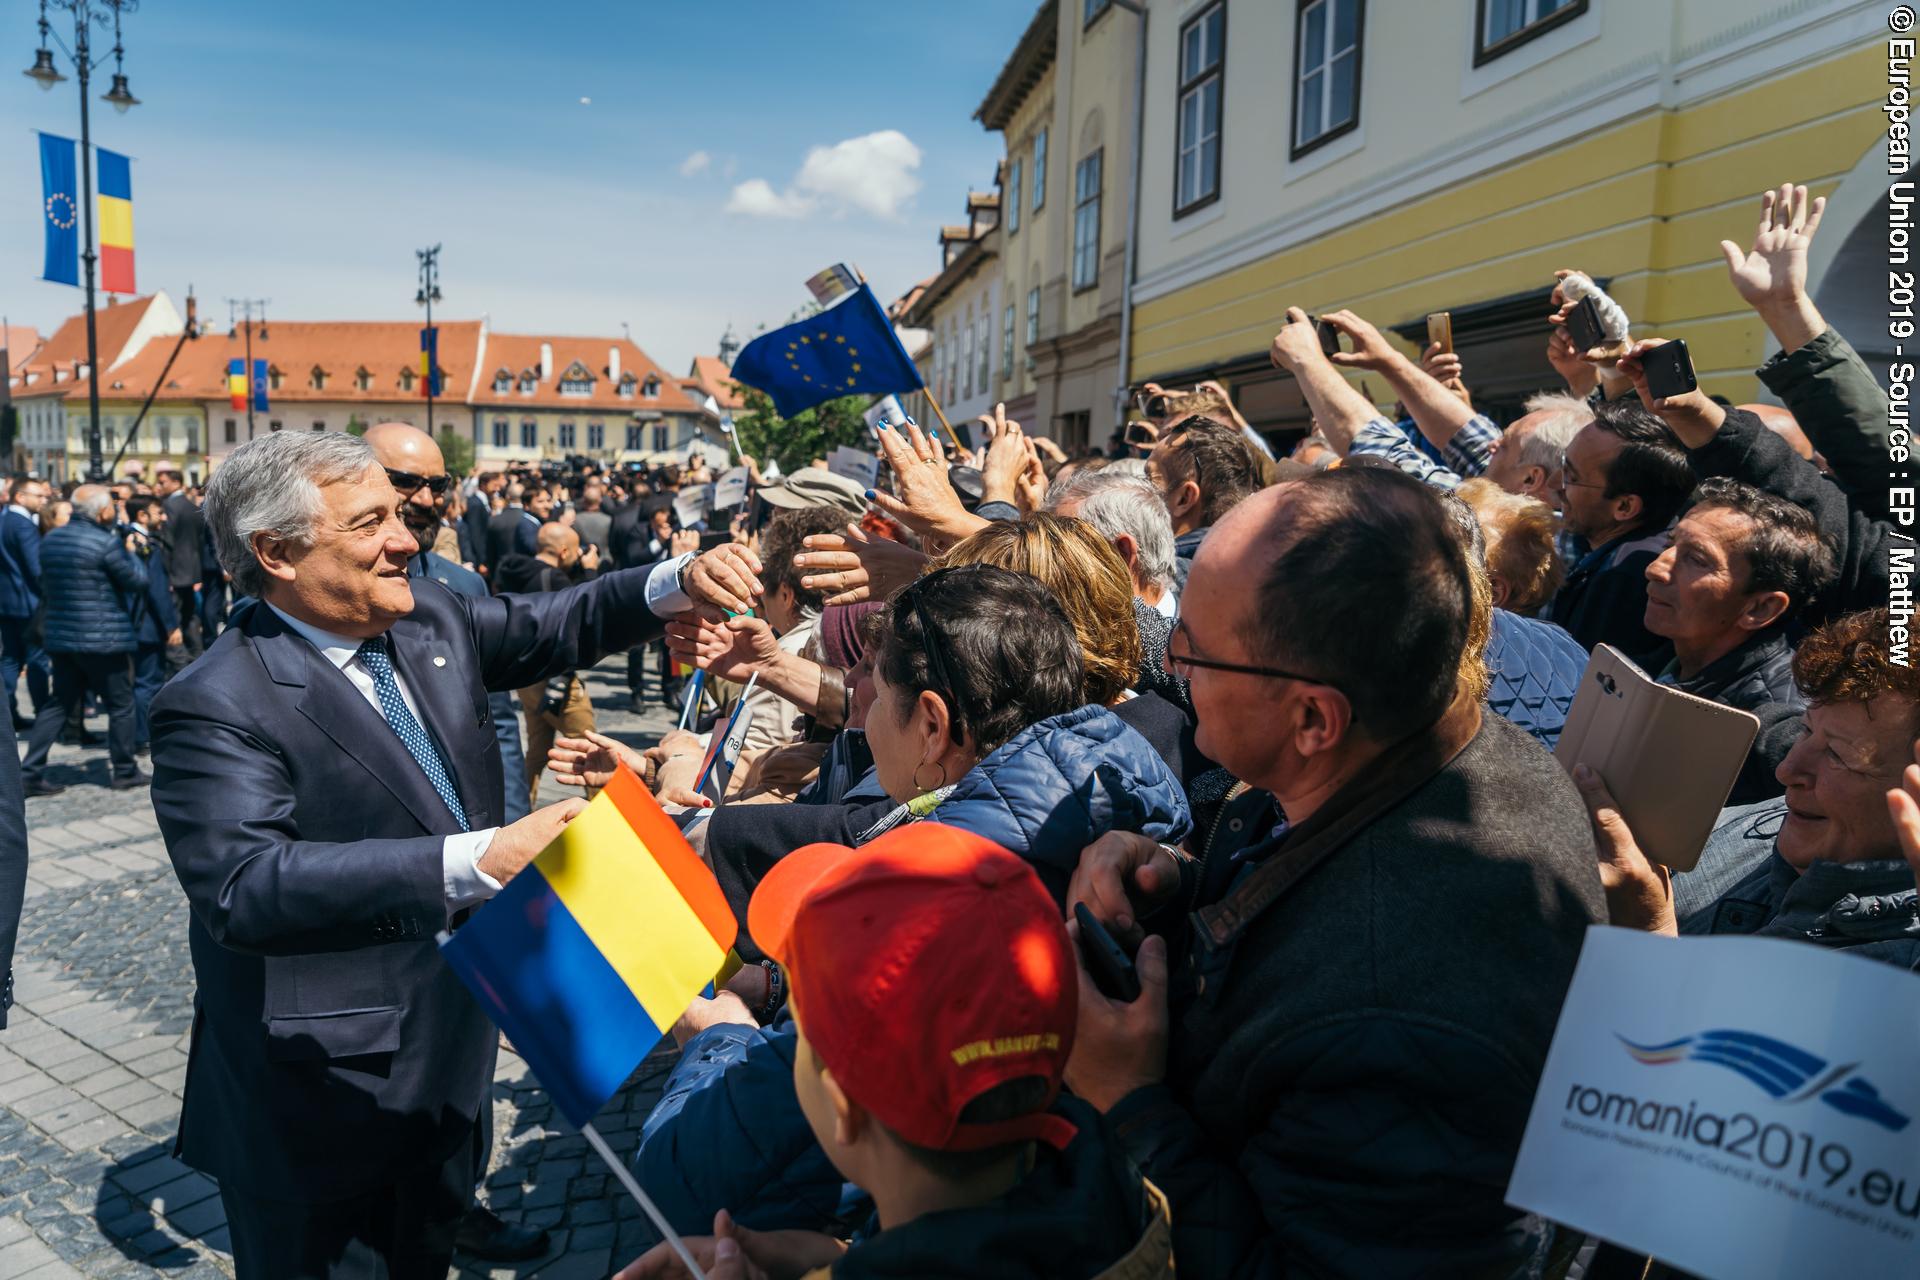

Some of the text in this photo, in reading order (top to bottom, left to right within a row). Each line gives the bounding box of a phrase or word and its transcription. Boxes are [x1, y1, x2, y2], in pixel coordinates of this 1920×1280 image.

[1565, 1083, 1920, 1220] romania2019.eu
[1693, 1151, 1753, 1182] Council
[1754, 1172, 1773, 1189] of
[1772, 1179, 1802, 1199] the
[1801, 1190, 1878, 1228] European
